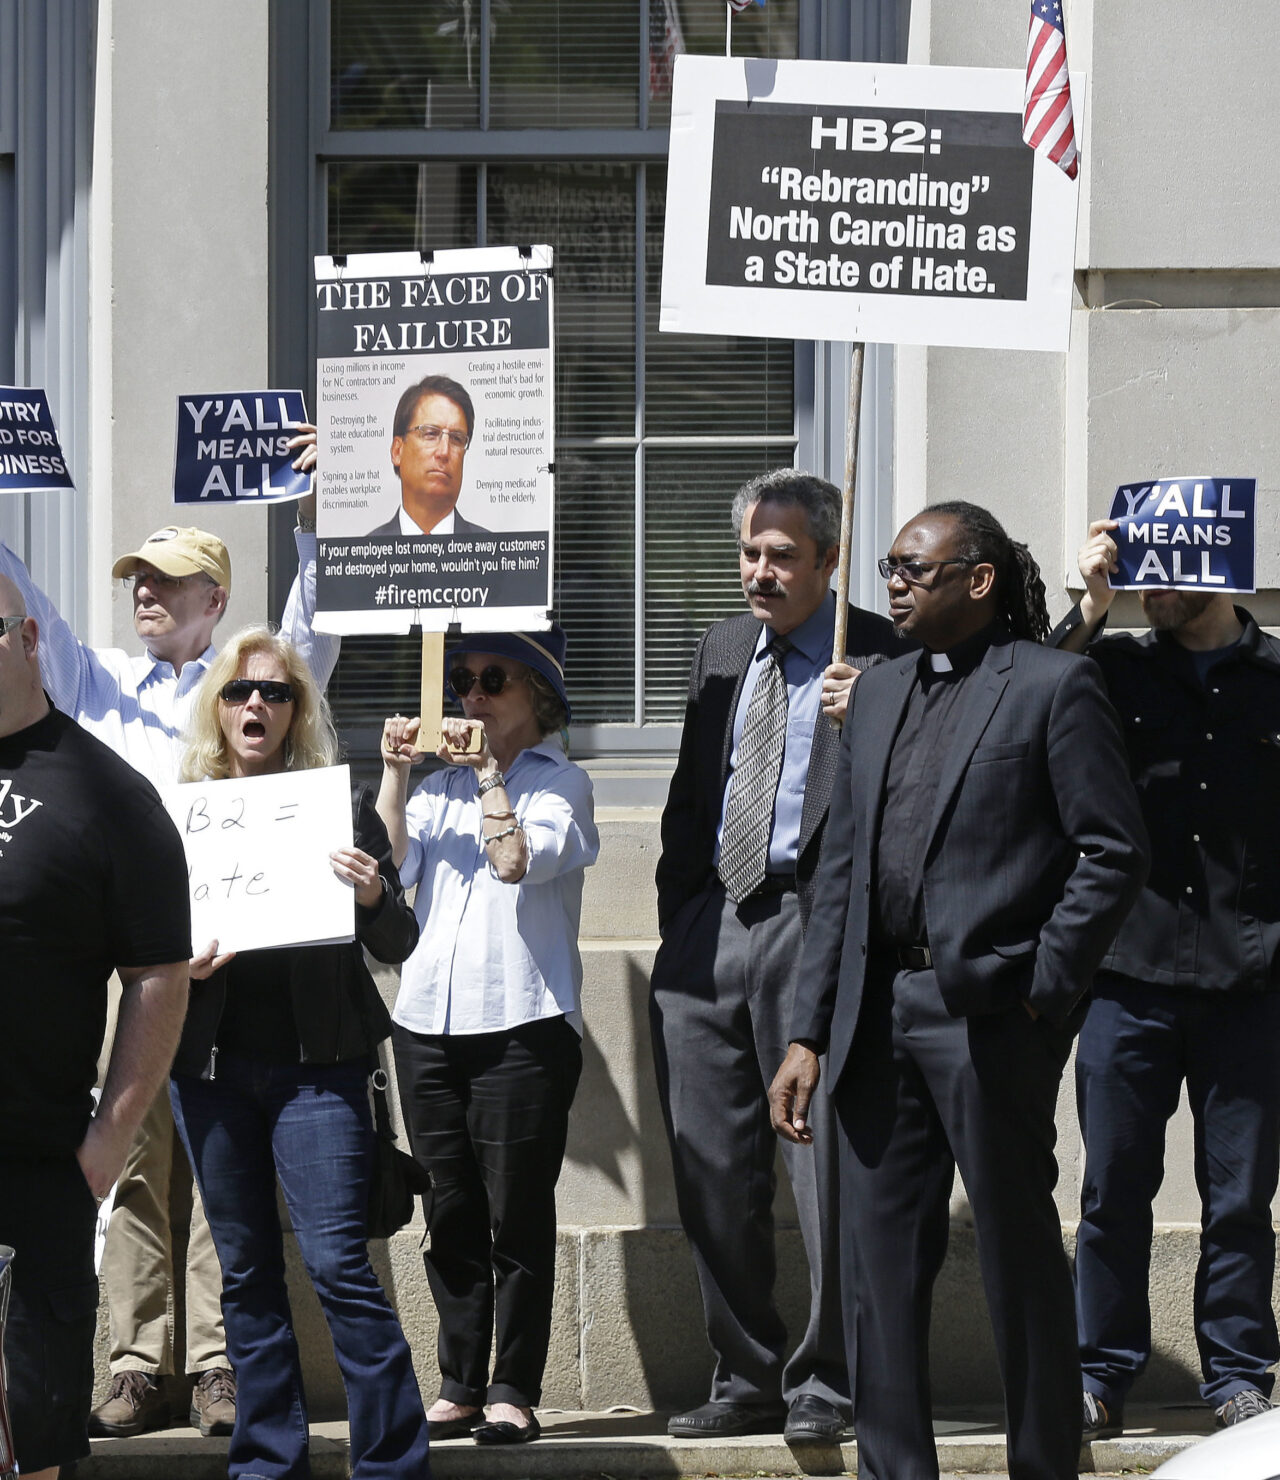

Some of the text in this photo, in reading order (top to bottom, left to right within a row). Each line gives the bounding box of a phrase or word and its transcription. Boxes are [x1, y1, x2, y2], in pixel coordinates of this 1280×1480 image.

[810, 116, 943, 155] HB2:
[728, 205, 1017, 253] North Carolina as
[743, 249, 996, 294] a State of Hate.
[316, 272, 548, 311] THE FACE OF
[352, 317, 512, 352] FAILURE
[322, 360, 406, 376] Losing millions in income
[468, 360, 496, 374] Creating
[496, 362, 501, 371] a
[502, 359, 526, 371] hostile
[322, 374, 396, 388] for NC contractors and
[470, 375, 498, 387] ronment
[519, 373, 534, 385] bad
[534, 372, 545, 384] for
[484, 388, 516, 400] economic
[330, 413, 378, 427] Destroying the
[484, 416, 521, 430] Facilitating
[16, 429, 56, 447] FOR
[330, 427, 385, 440] state educational
[482, 429, 545, 443] trial destruction of
[196, 435, 292, 461] MEANS
[485, 445, 508, 457] natural
[199, 462, 287, 498] ALL
[322, 469, 380, 484] Signing a law that
[476, 477, 537, 492] Denying medicaid
[322, 483, 382, 497] enables workplace
[489, 494, 497, 504] to
[498, 492, 510, 504] the
[1127, 521, 1232, 546] MEANS
[319, 539, 546, 561] If your employee lost money, drove away customers
[324, 560, 343, 576] and
[344, 559, 388, 578] destroyed
[389, 562, 410, 578] your
[411, 559, 439, 575] home,
[481, 560, 499, 576] you
[500, 556, 516, 571] fire
[518, 556, 540, 571] him?
[1134, 549, 1226, 585] ALL
[374, 583, 489, 607] #firemccrory
[185, 796, 246, 835] B2
[187, 861, 271, 901] ate
